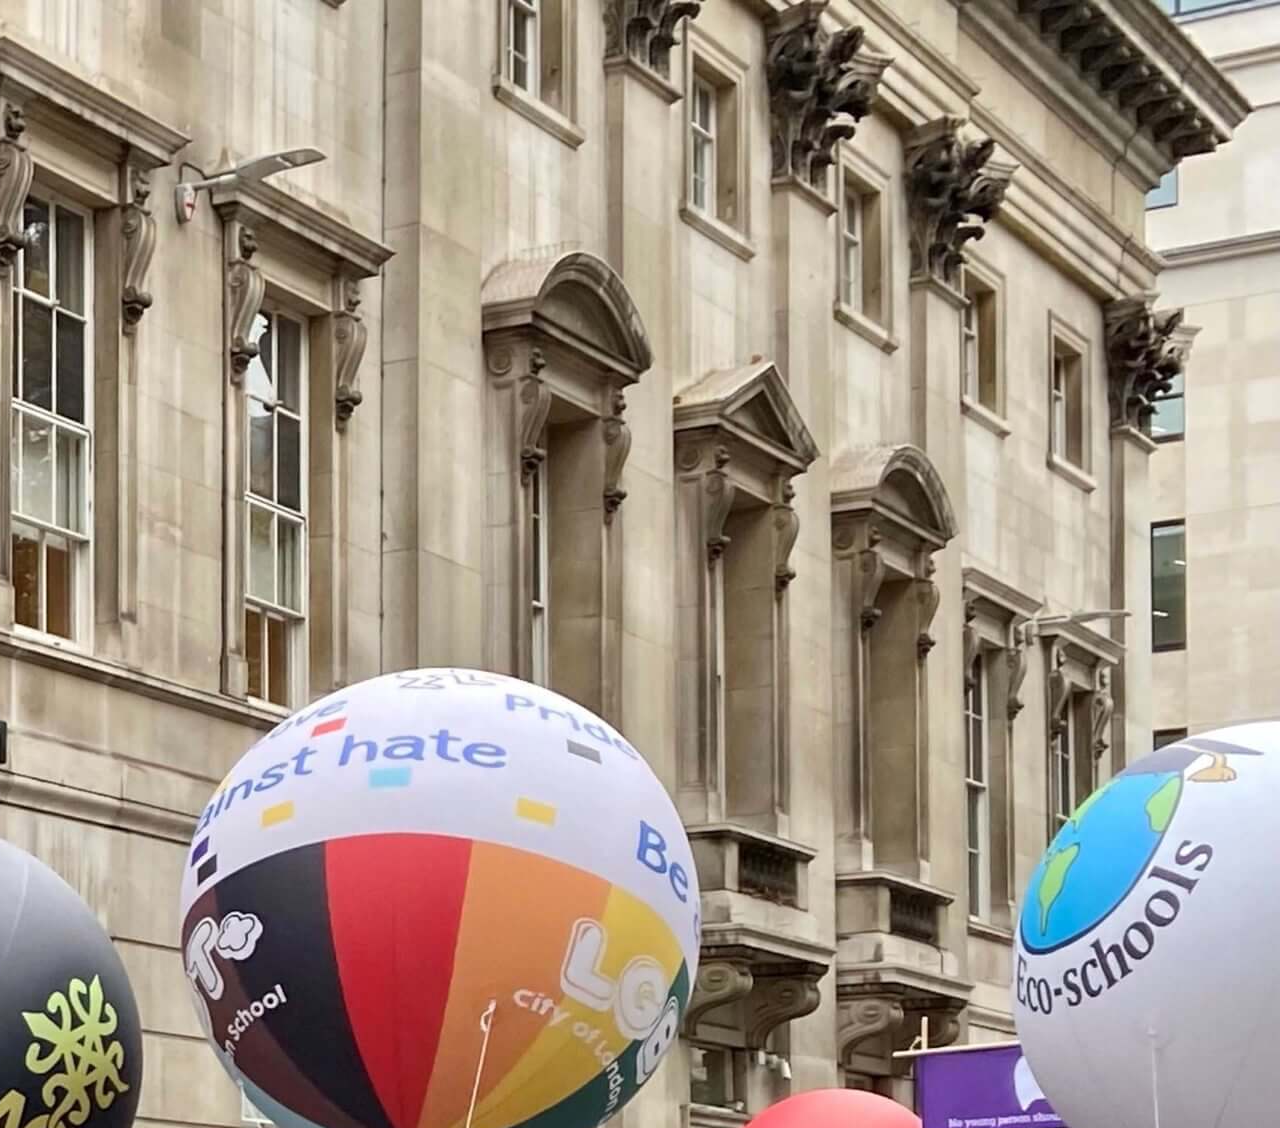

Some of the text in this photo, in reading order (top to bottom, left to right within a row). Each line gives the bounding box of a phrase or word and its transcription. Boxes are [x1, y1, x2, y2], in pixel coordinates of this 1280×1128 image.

[269, 700, 349, 740] ove
[505, 693, 639, 761] Pride
[196, 728, 507, 834] ainst hate
[636, 818, 688, 903] Be
[1016, 838, 1215, 1017] Eco-schools
[512, 988, 571, 1027] City
